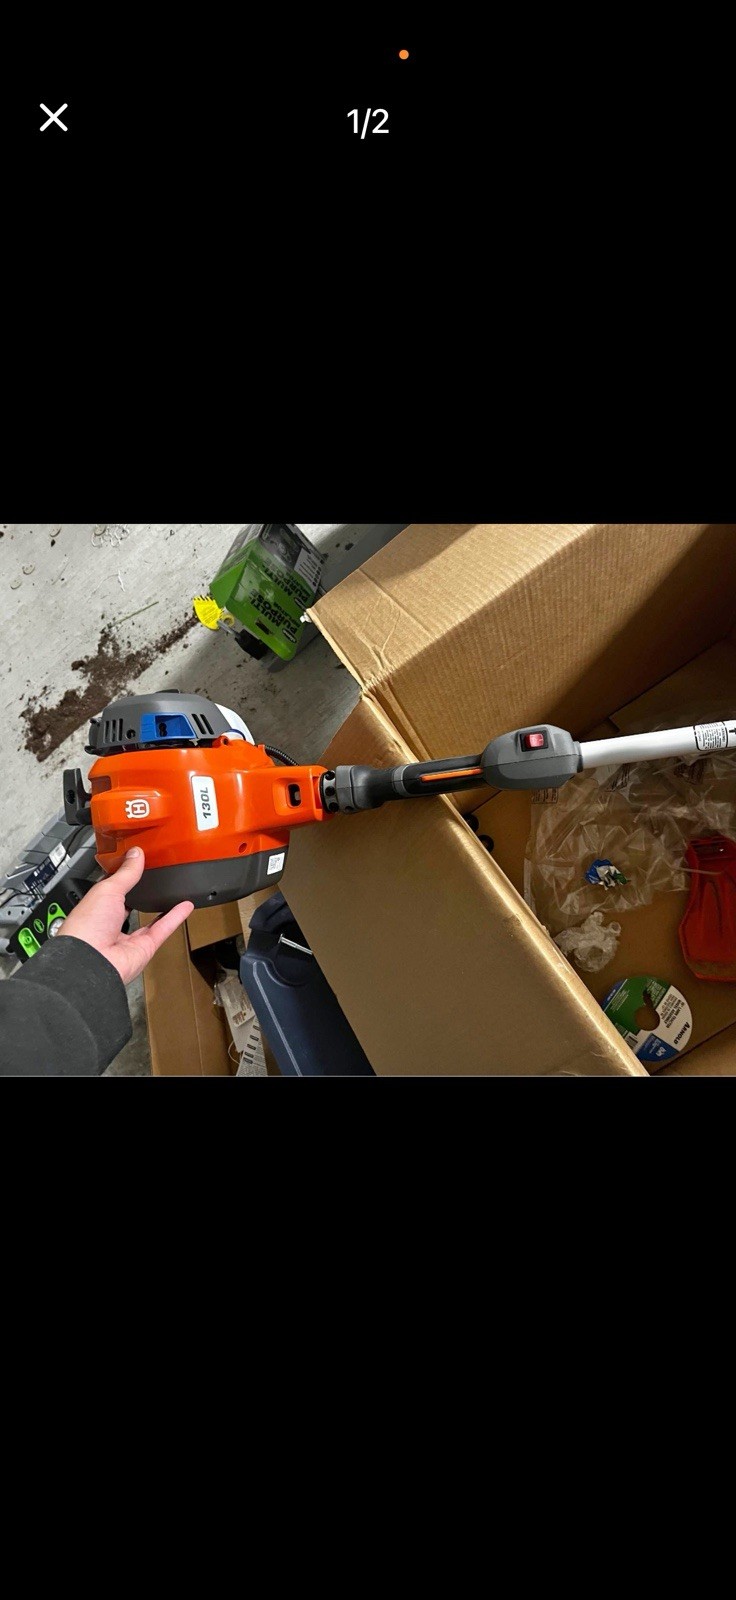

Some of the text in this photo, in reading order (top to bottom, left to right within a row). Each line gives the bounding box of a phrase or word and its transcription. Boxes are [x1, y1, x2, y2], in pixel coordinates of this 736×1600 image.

[250, 589, 298, 634] PURPOSE
[200, 787, 211, 818] 130L
[674, 1022, 690, 1044] ARNOLD
